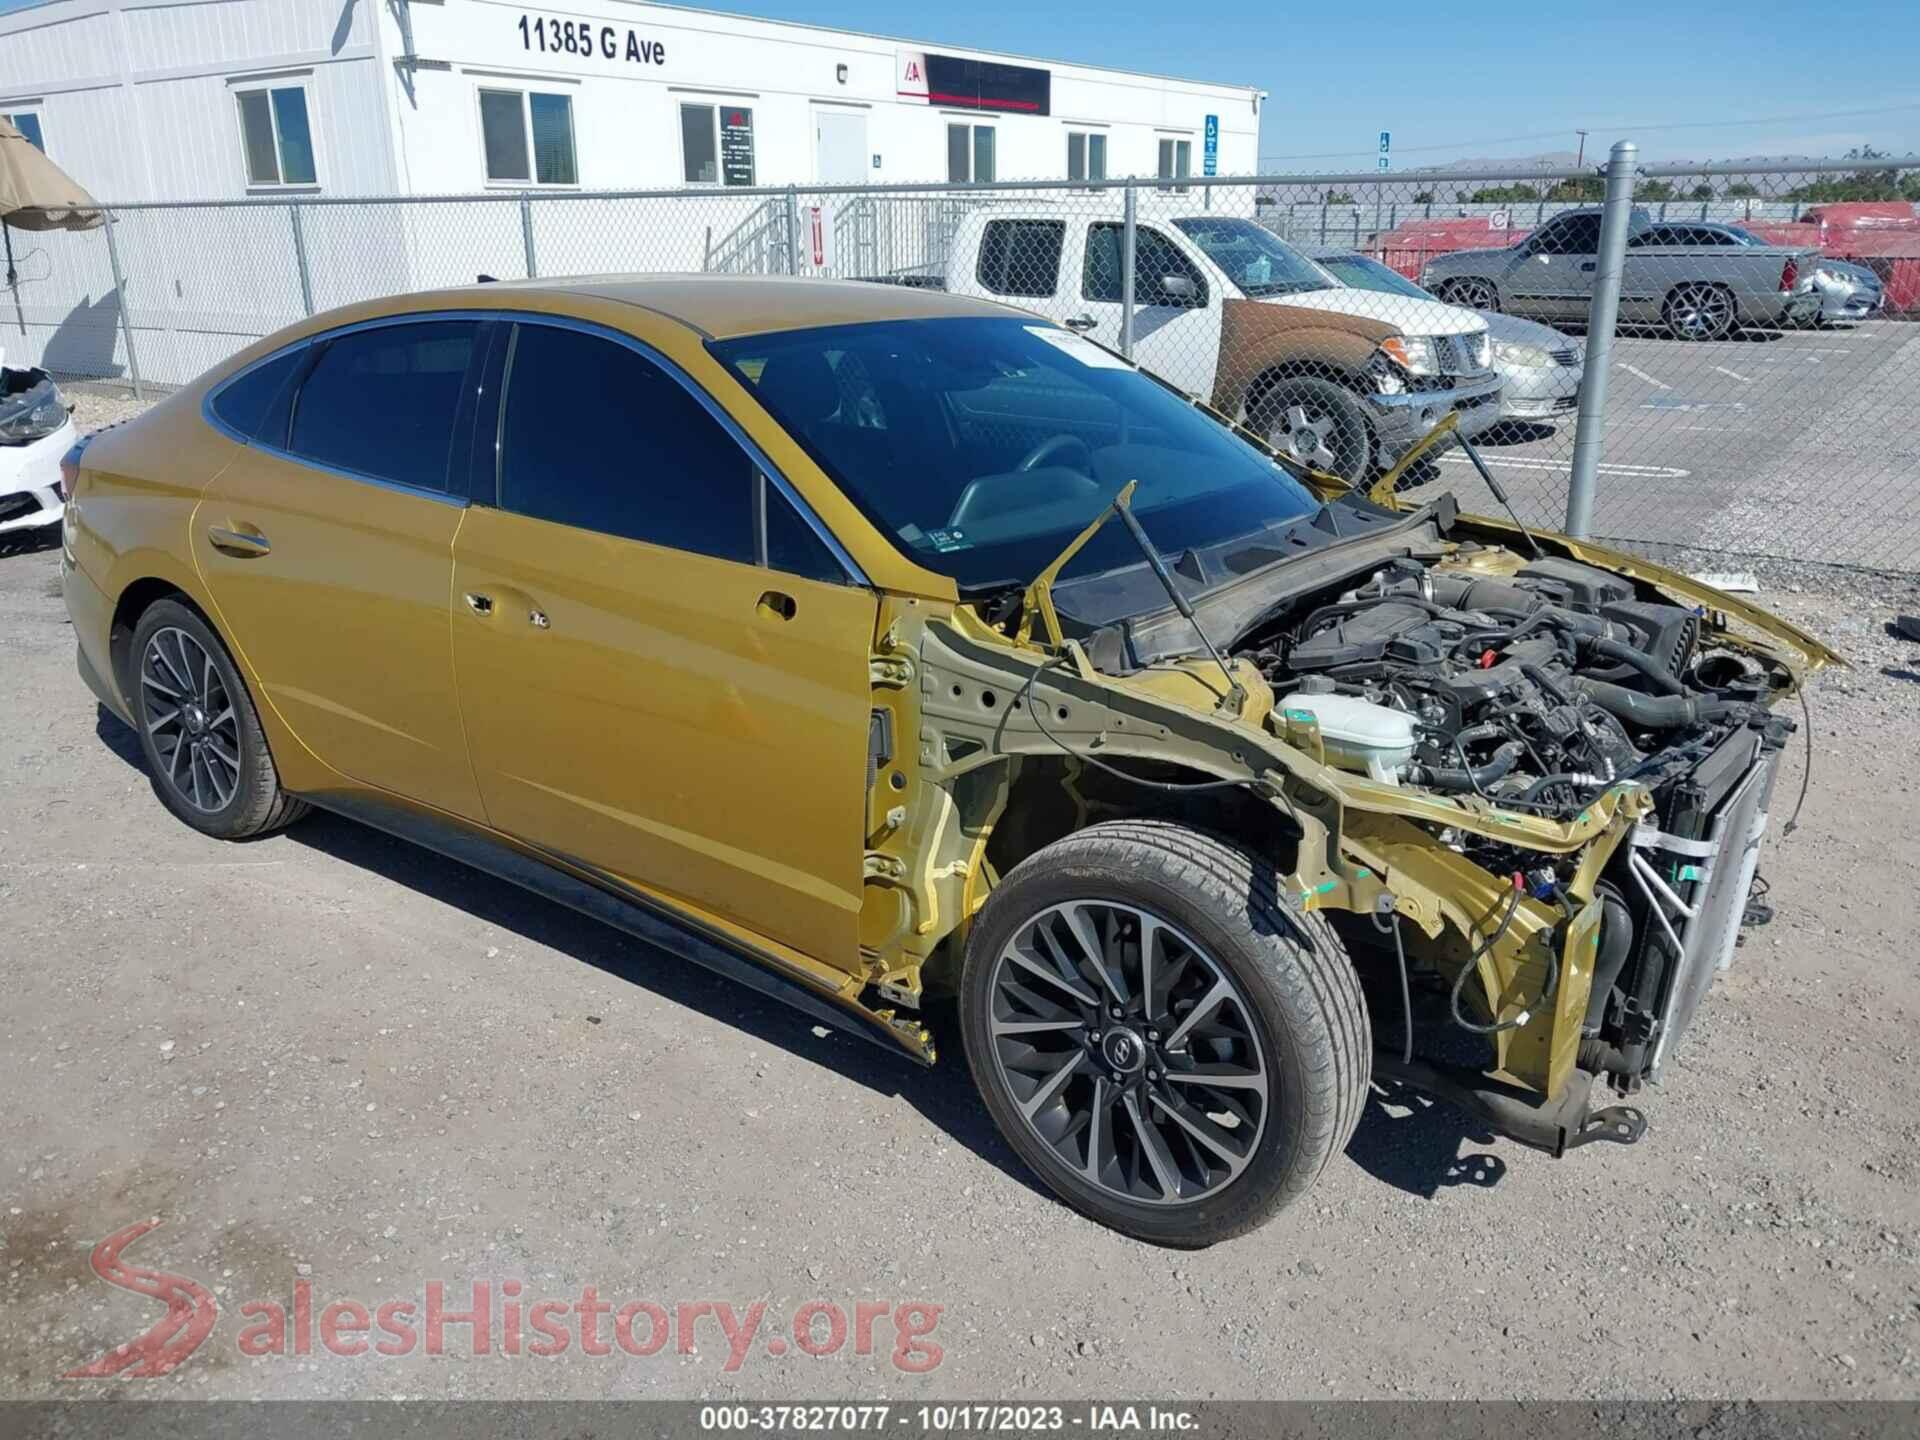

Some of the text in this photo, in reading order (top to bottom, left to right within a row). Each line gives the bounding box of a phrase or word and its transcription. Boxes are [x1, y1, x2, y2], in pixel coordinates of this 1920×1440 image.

[518, 14, 665, 66] 11385 G Ave
